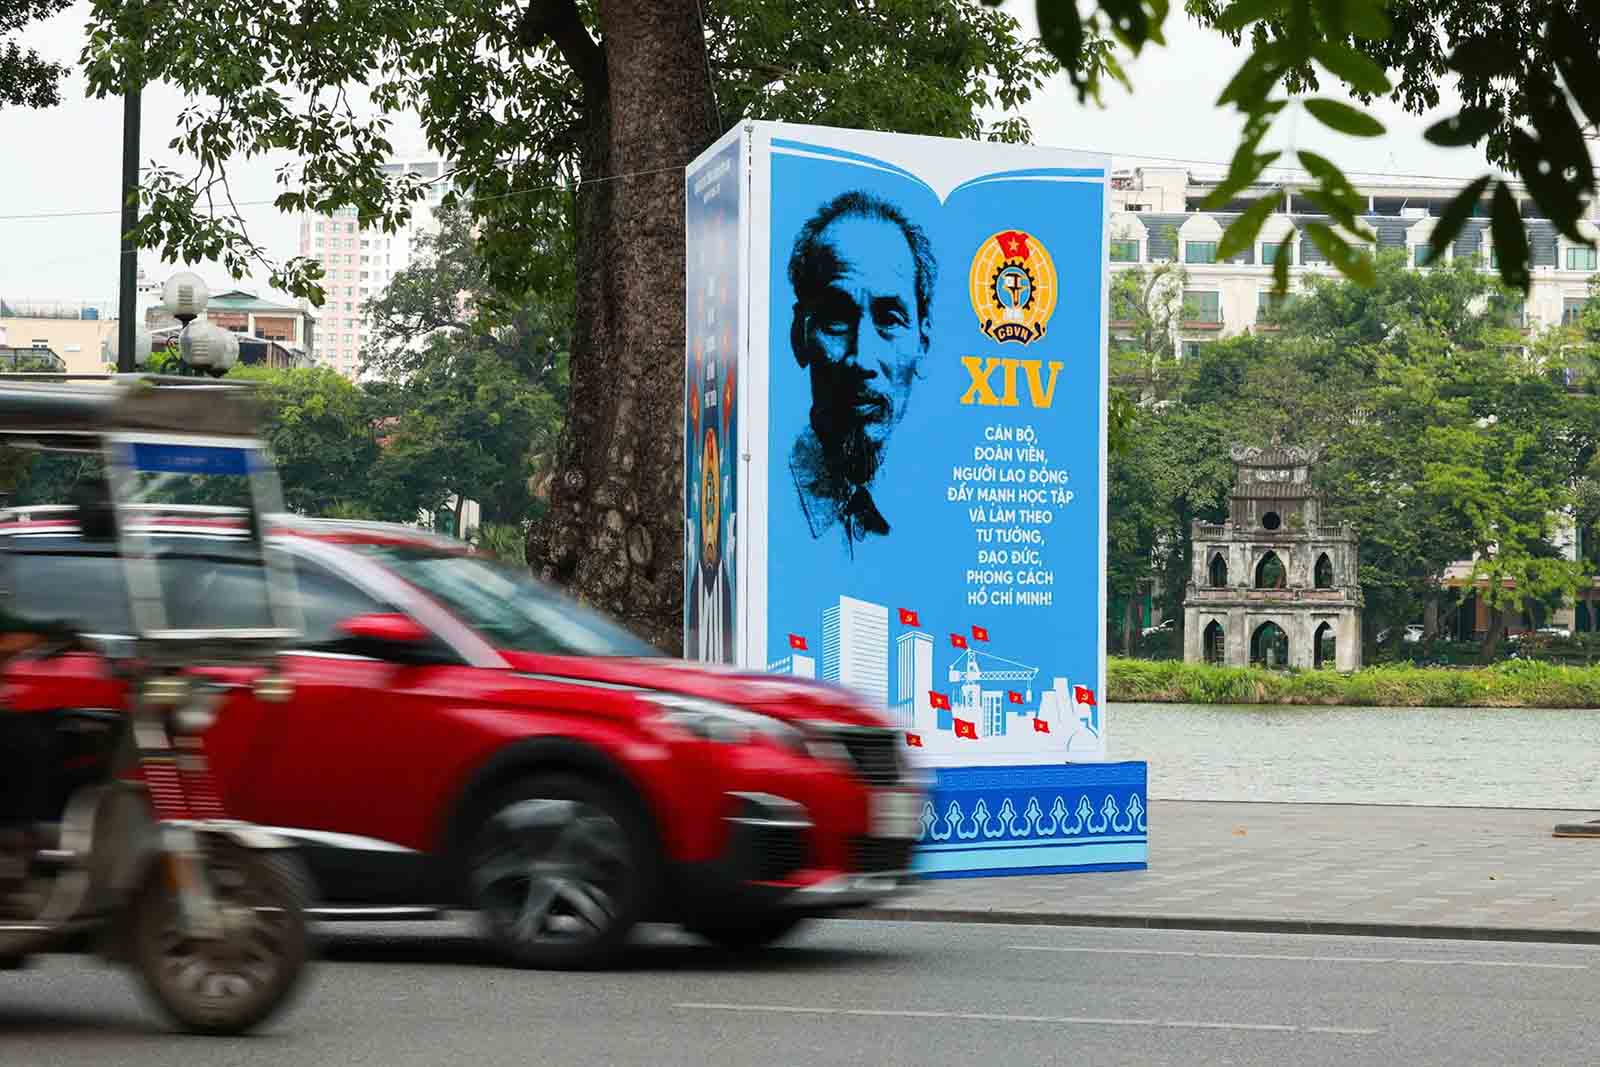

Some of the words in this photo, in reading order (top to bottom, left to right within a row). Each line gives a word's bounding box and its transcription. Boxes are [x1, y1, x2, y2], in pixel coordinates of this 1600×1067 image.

[960, 356, 1064, 409] XIV
[985, 424, 1012, 441] CÁN
[1016, 425, 1038, 446] BỘ,
[974, 444, 1013, 461] ĐOÀN
[1016, 446, 1048, 465] VIÊN,
[953, 464, 996, 481] NGƯỜI
[1000, 469, 1026, 482] LAO
[1029, 466, 1069, 487] ĐỘNG
[947, 482, 974, 501] ĐẨY
[977, 488, 1015, 507] MẠNH
[1018, 488, 1048, 507] HỌC
[1050, 487, 1074, 509] TẬP
[968, 505, 986, 522] VÀ
[989, 506, 1016, 523] LÀM
[1018, 509, 1053, 524] THEO
[976, 528, 993, 543] TƯ
[995, 525, 1045, 546] TƯỞNG,
[978, 550, 1008, 568] ĐẠO
[1011, 545, 1042, 567] ĐỨC,
[967, 570, 1014, 585] PHONG
[1016, 567, 1054, 585] CÁCH
[967, 586, 988, 605] HỒ
[990, 587, 1013, 606] CHÍ
[1016, 591, 1053, 606] MINH!
